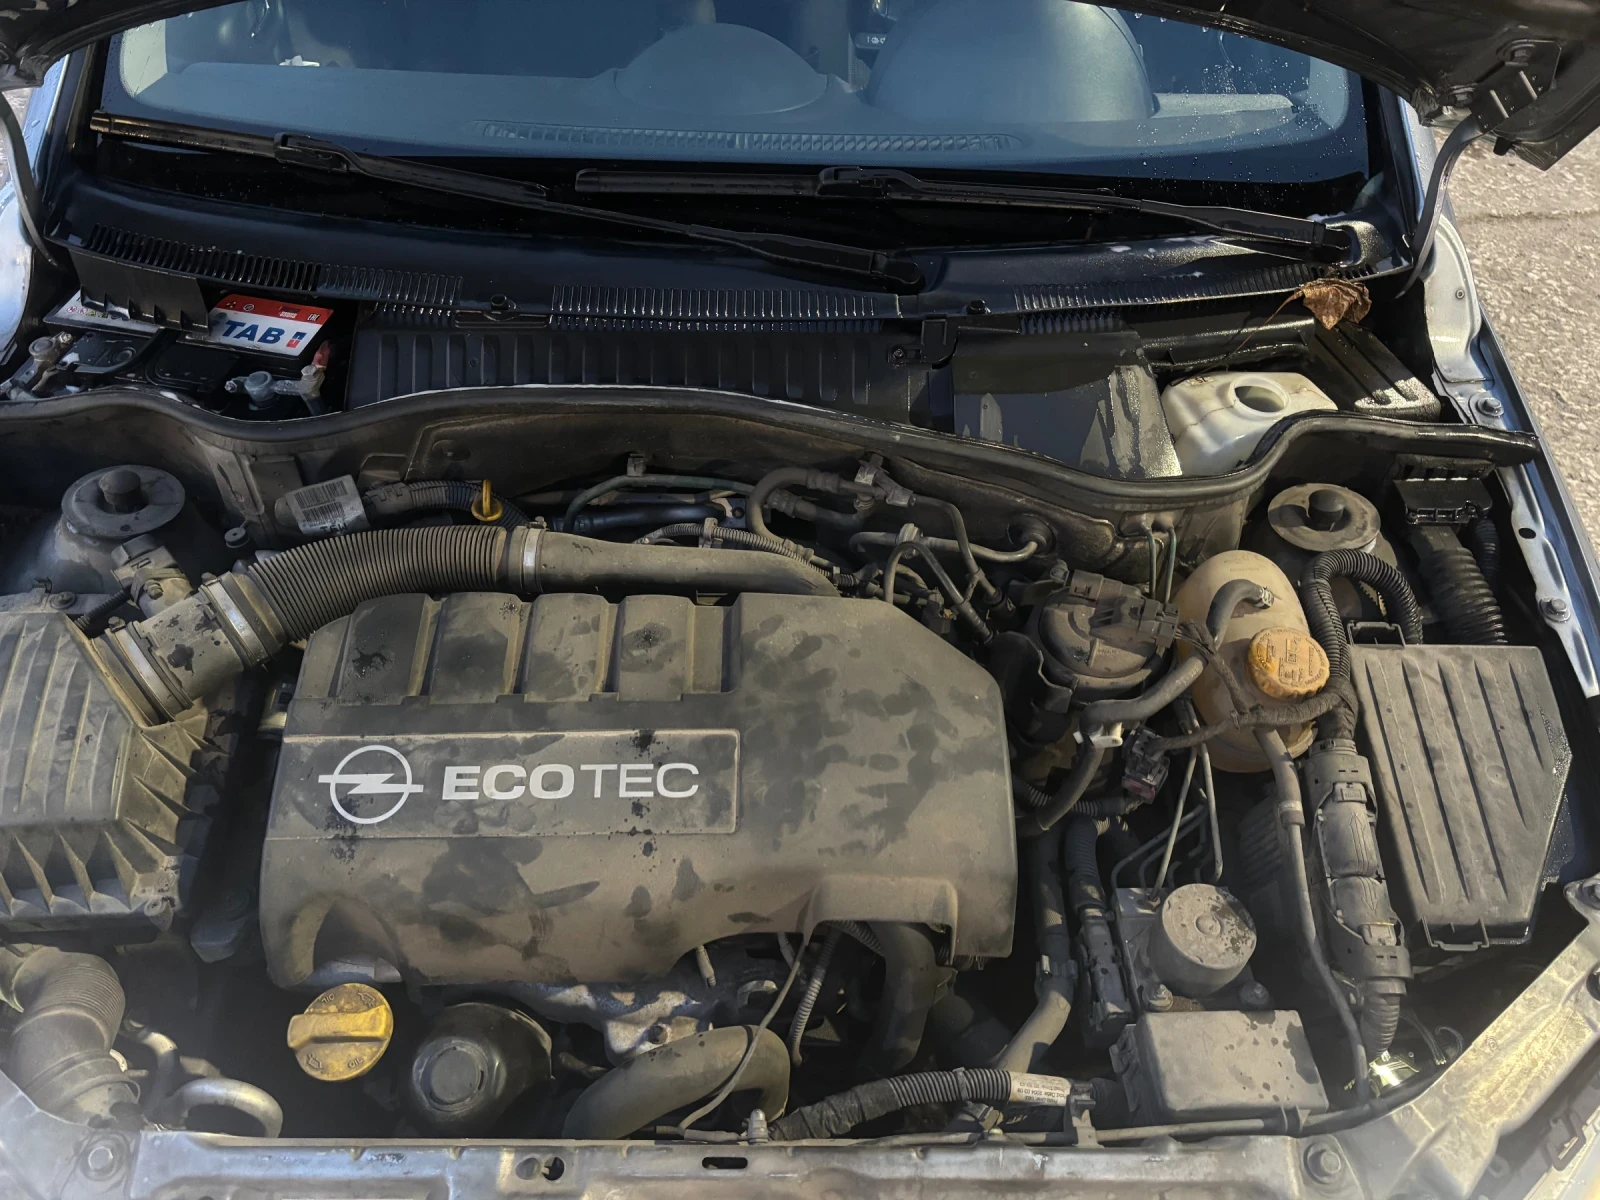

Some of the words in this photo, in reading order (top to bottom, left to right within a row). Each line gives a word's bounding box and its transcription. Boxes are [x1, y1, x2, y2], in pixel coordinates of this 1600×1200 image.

[222, 320, 285, 344] TAB
[442, 763, 700, 800] ECOTEC
[321, 993, 335, 1004] OIL
[347, 1058, 363, 1069] OIL
